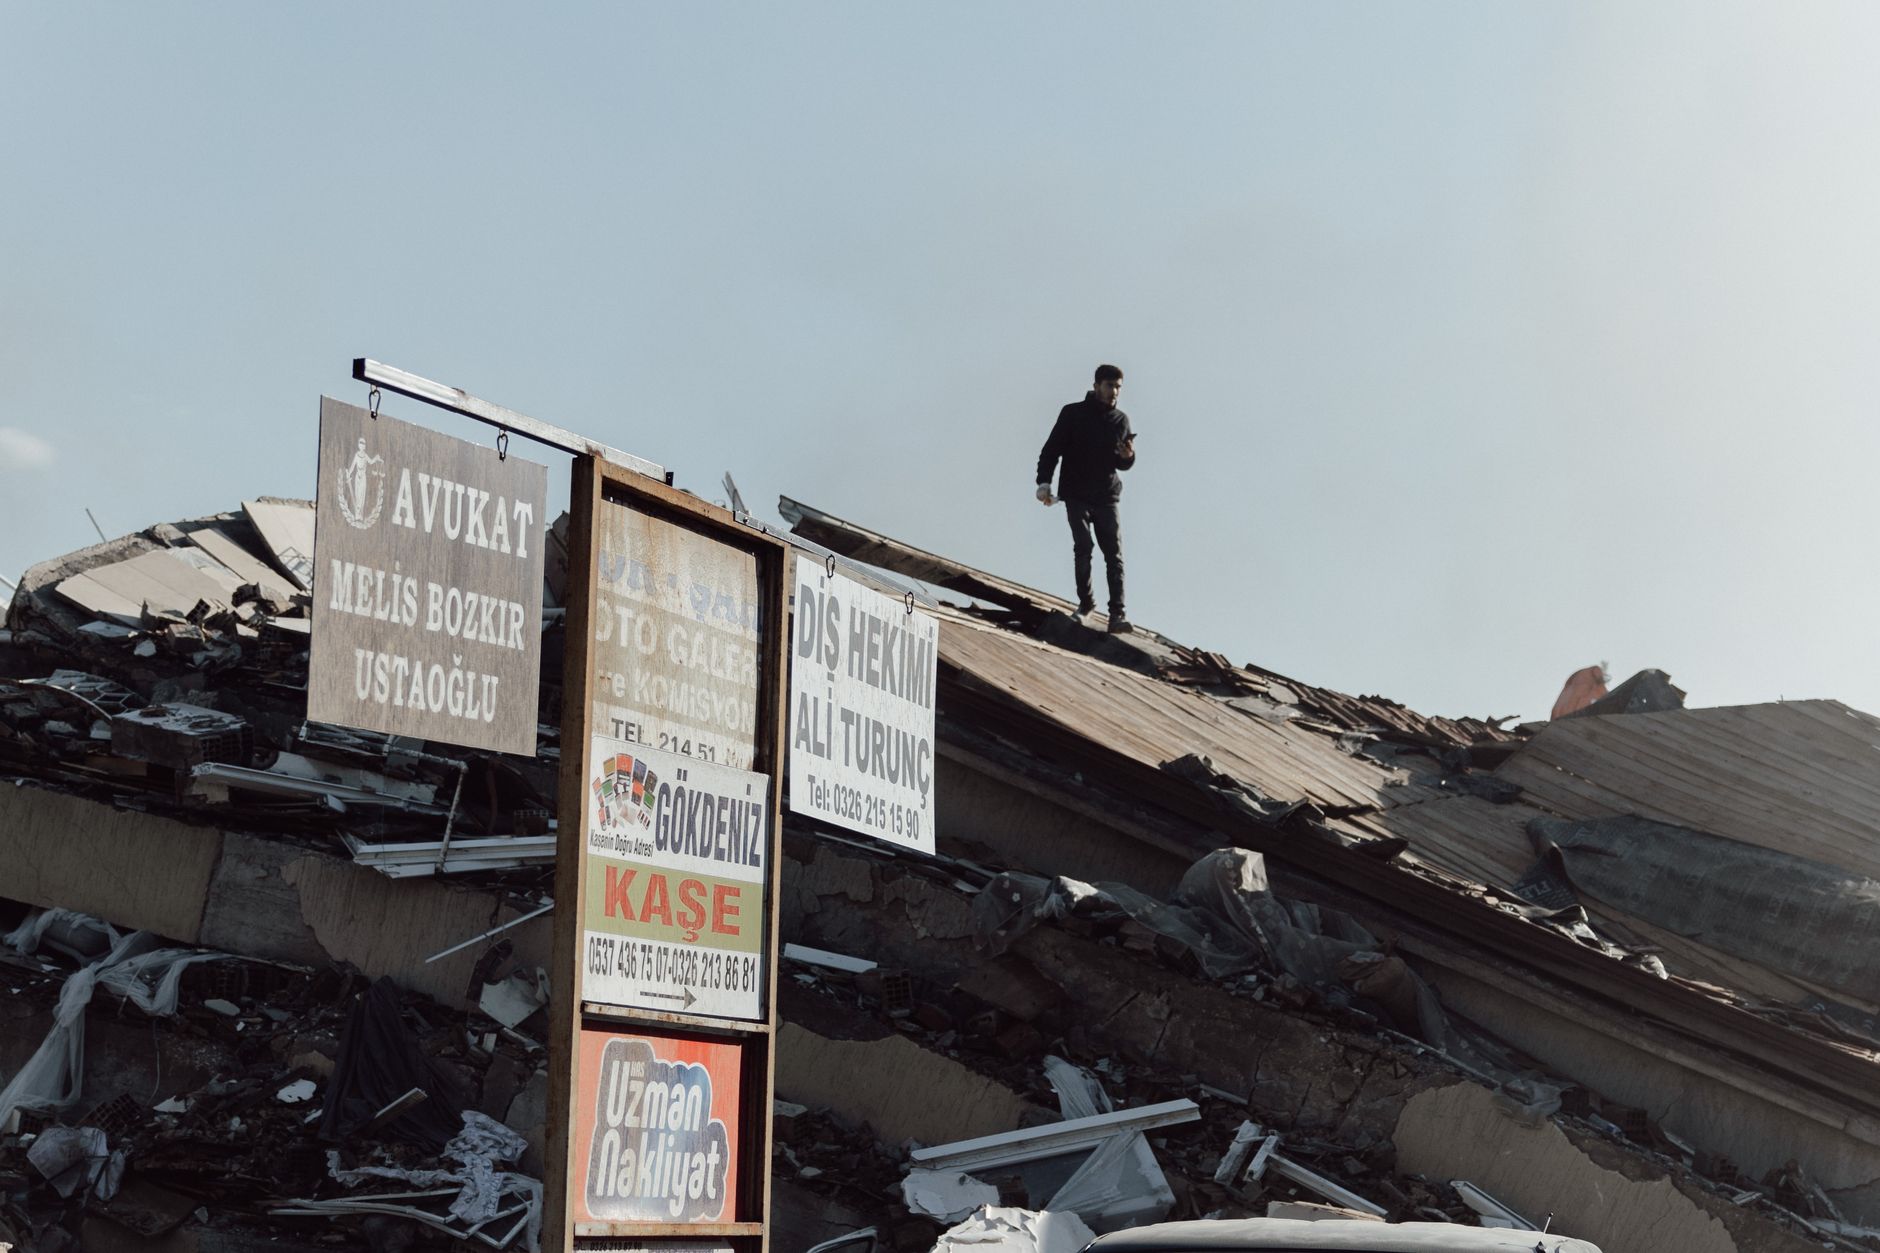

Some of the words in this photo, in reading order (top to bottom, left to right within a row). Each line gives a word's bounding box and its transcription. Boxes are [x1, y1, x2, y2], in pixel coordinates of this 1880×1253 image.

[392, 468, 533, 559] AVUKAT
[329, 559, 418, 628] MELİS
[426, 581, 525, 651] BOZKIR
[798, 576, 840, 683] DİŞ
[848, 605, 934, 709] HEKİMİ
[355, 648, 499, 724] USTAOĞLU
[660, 732, 692, 756] 214
[794, 687, 832, 761] ALİ
[840, 707, 930, 810] TURUNÇ
[590, 829, 614, 851] Kaşenin
[614, 833, 633, 856] Doğru
[633, 838, 655, 857] Adresi
[655, 768, 762, 868] GÖKDENİZ
[807, 774, 830, 812] Tel:
[834, 783, 862, 822] 0326
[865, 794, 886, 830] 215
[889, 800, 903, 835] 15
[906, 809, 919, 840] 90
[604, 865, 741, 943] KAŞE
[589, 936, 615, 976] 0537
[618, 940, 637, 979] 436
[640, 944, 653, 981] 75
[700, 952, 722, 989] 213
[724, 955, 739, 991] 86
[742, 957, 756, 992] 81
[606, 1060, 702, 1131] Uzman
[595, 1129, 720, 1217] Nakliyat
